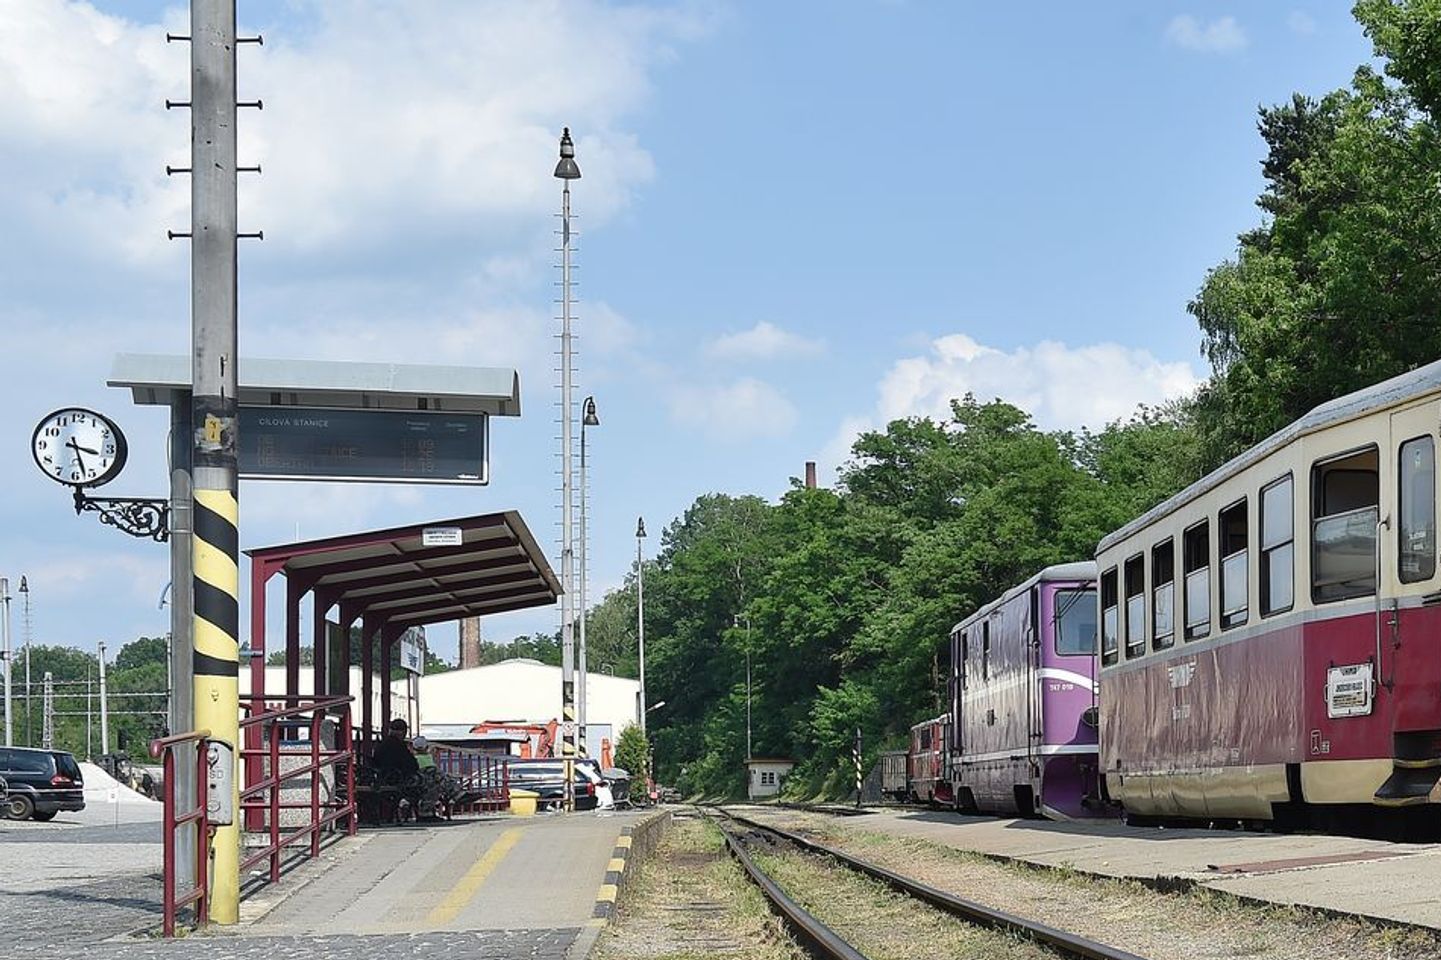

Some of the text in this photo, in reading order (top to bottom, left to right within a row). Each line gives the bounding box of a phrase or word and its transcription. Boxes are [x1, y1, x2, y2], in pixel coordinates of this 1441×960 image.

[56, 417, 67, 427] 11
[72, 413, 86, 424] 12
[92, 418, 97, 428] 1
[45, 427, 60, 437] 10
[101, 429, 109, 439] 2
[38, 440, 48, 450] 9
[106, 444, 115, 454] 3
[43, 455, 53, 464] 8
[98, 458, 107, 468] 4
[54, 466, 63, 477] 7
[70, 471, 80, 481] 6
[87, 468, 97, 478] 5
